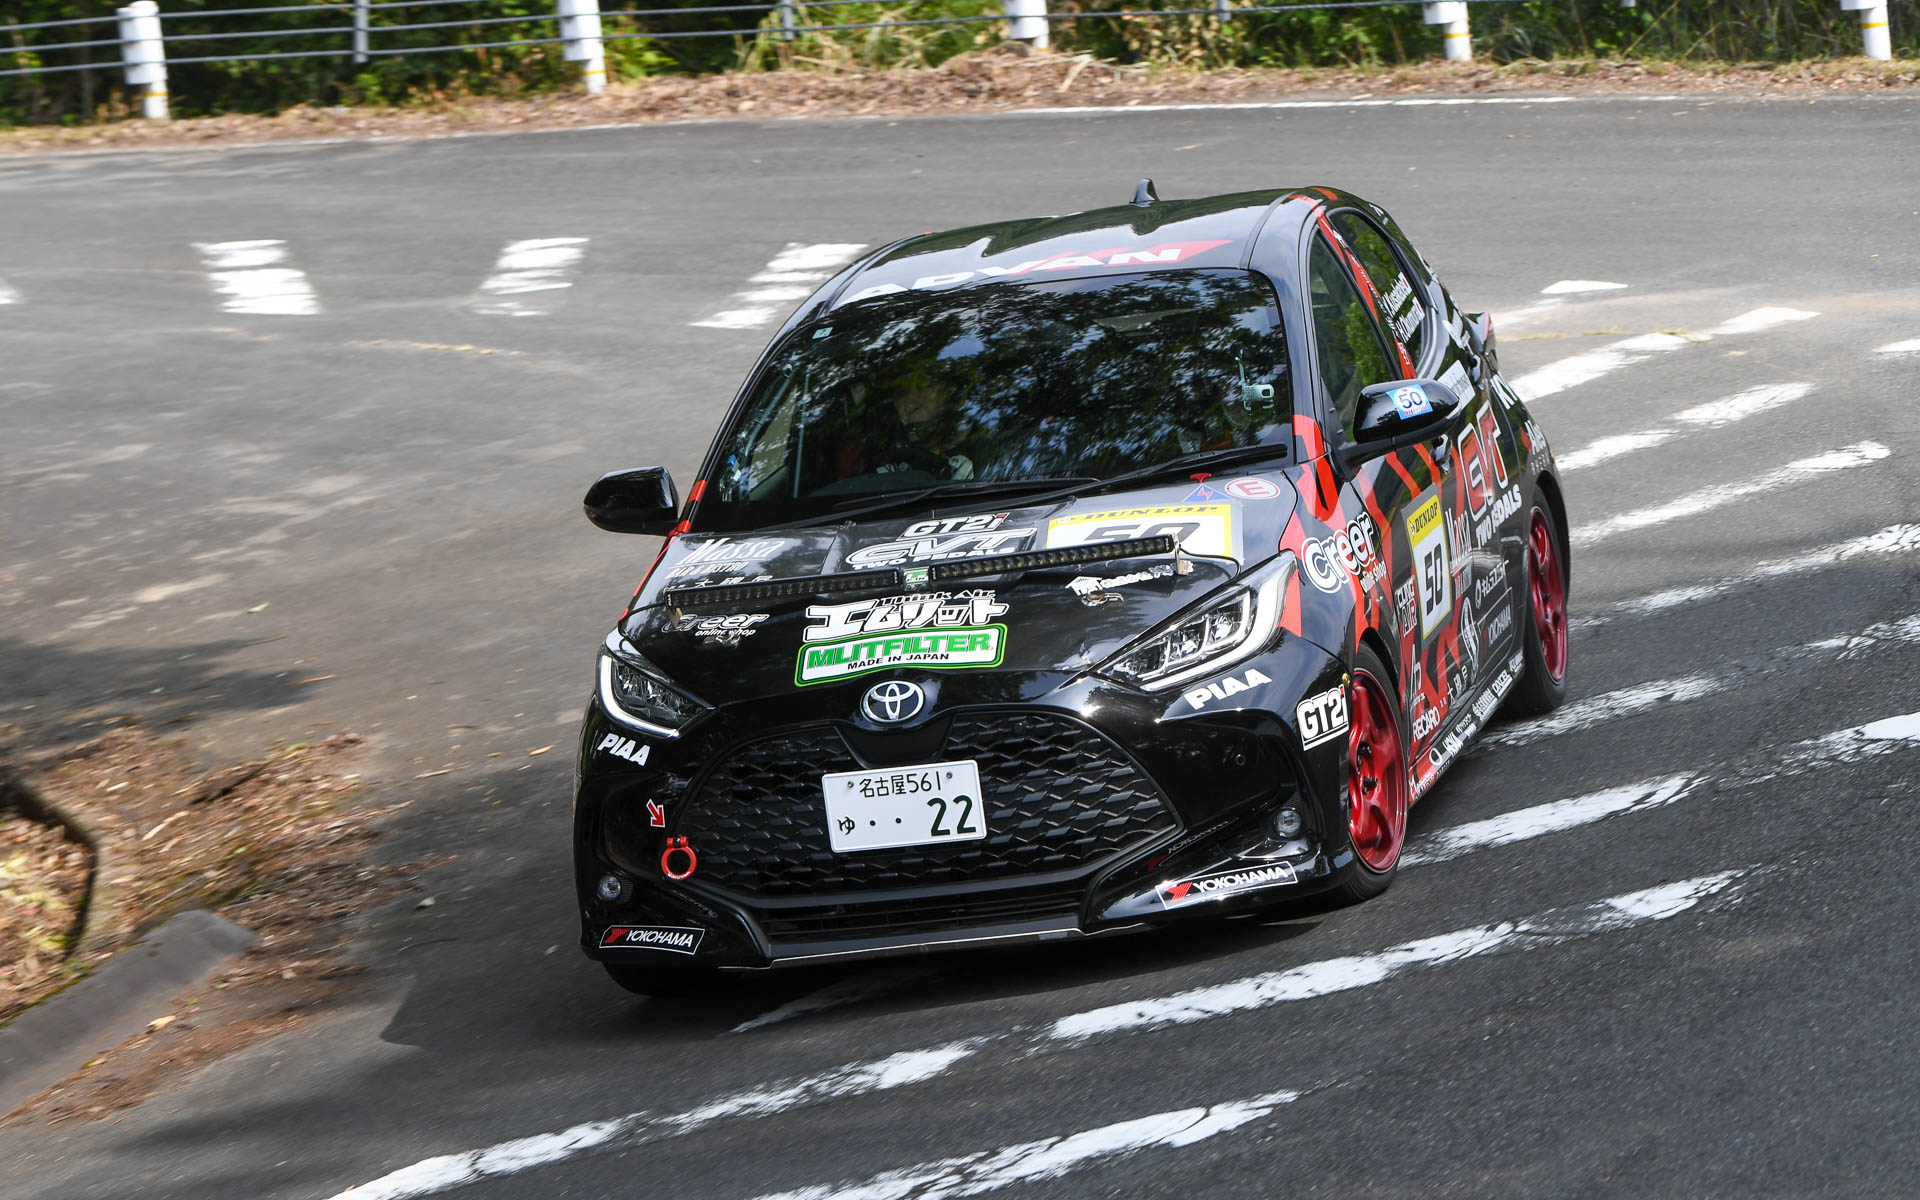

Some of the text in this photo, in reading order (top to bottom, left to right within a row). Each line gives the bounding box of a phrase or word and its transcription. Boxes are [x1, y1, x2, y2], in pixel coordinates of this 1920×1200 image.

[835, 248, 1183, 305] ADVAN
[1399, 391, 1423, 409] 50
[1083, 506, 1219, 520] DUNLOP
[1415, 502, 1439, 534] DUNLOP
[846, 528, 1037, 564] CVT
[1475, 516, 1492, 550] TWO
[675, 538, 786, 566] Massa
[852, 557, 908, 571] TWO
[1301, 512, 1377, 593] Creer
[1424, 543, 1444, 617] 50
[695, 628, 727, 637] online
[802, 598, 1010, 643] エムリット
[806, 632, 991, 669] MLITFILTER
[847, 653, 949, 671] MADE IN JAPAN
[1184, 668, 1272, 711] PIAA
[1412, 706, 1441, 743] RECARO
[597, 733, 651, 767] PIAA
[837, 816, 856, 835] ゆ
[927, 794, 977, 837] 22
[1193, 866, 1289, 893] YOKOHAMA
[626, 930, 694, 948] YOKOHAMA
